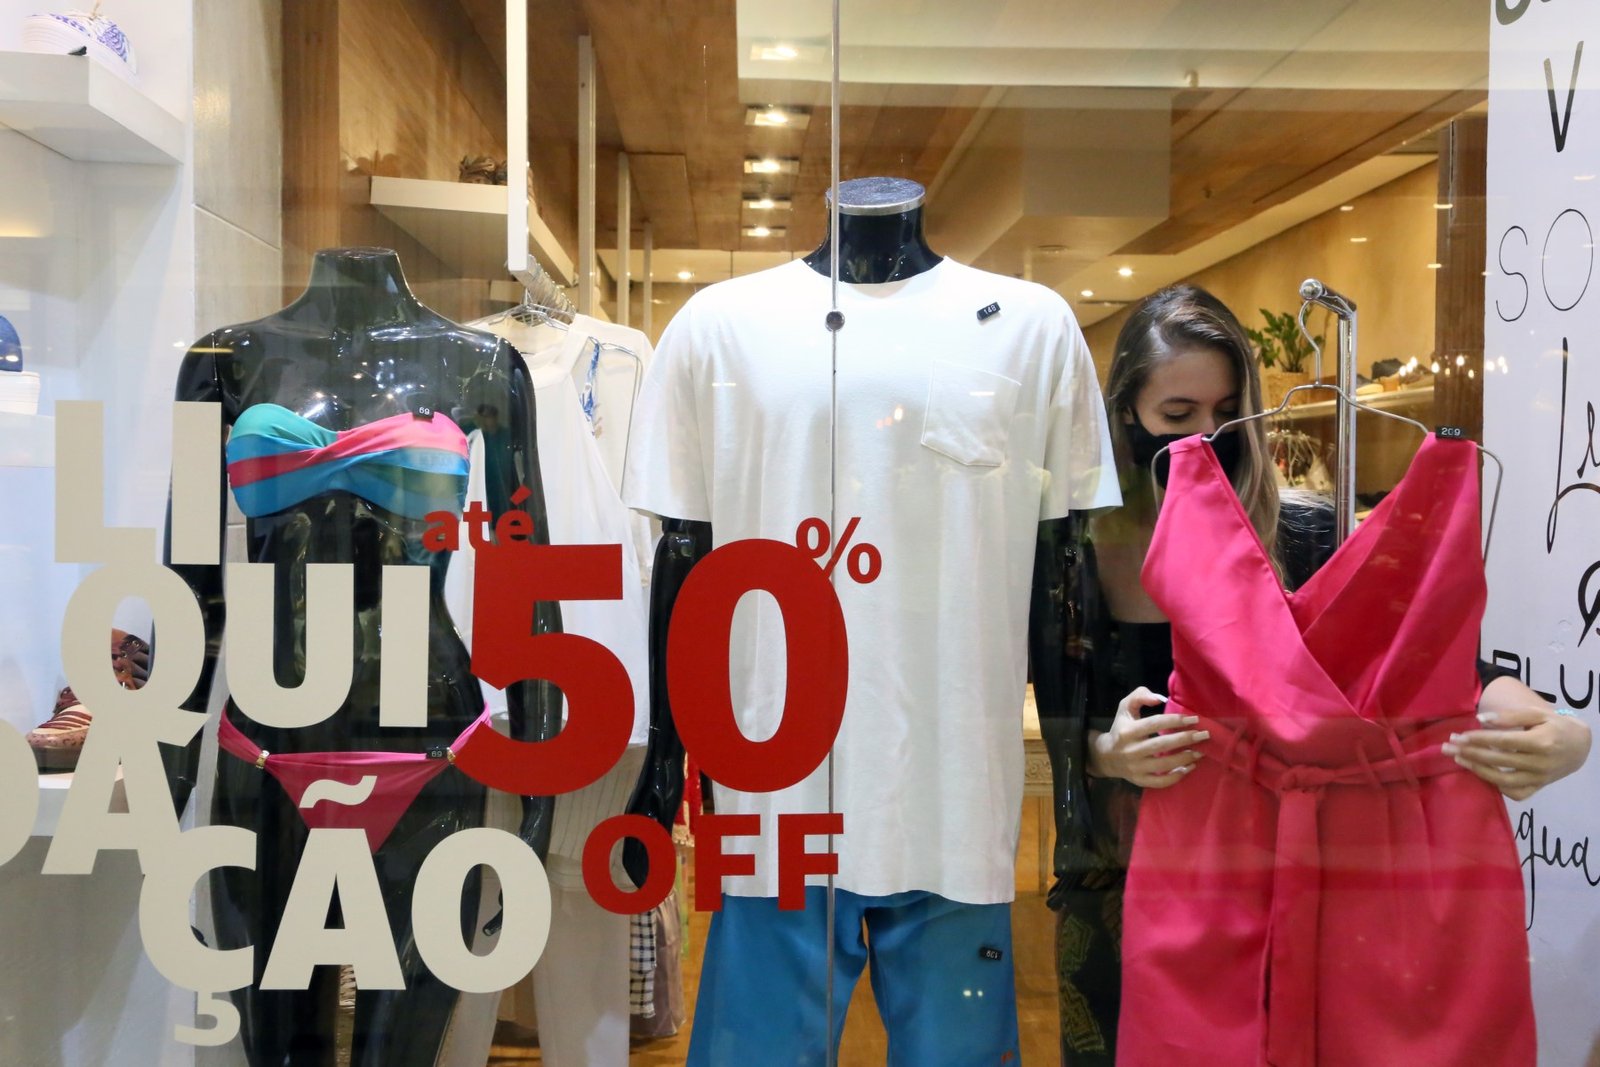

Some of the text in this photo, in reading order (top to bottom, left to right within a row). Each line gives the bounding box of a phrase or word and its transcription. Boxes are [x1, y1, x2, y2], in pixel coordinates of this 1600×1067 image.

[55, 400, 221, 565] LI
[1441, 427, 1461, 436] 209
[421, 485, 534, 552] até
[61, 562, 431, 747] QUI
[452, 517, 882, 796] 50%
[139, 776, 552, 1047] ÇÃO
[582, 813, 844, 915] OFF
